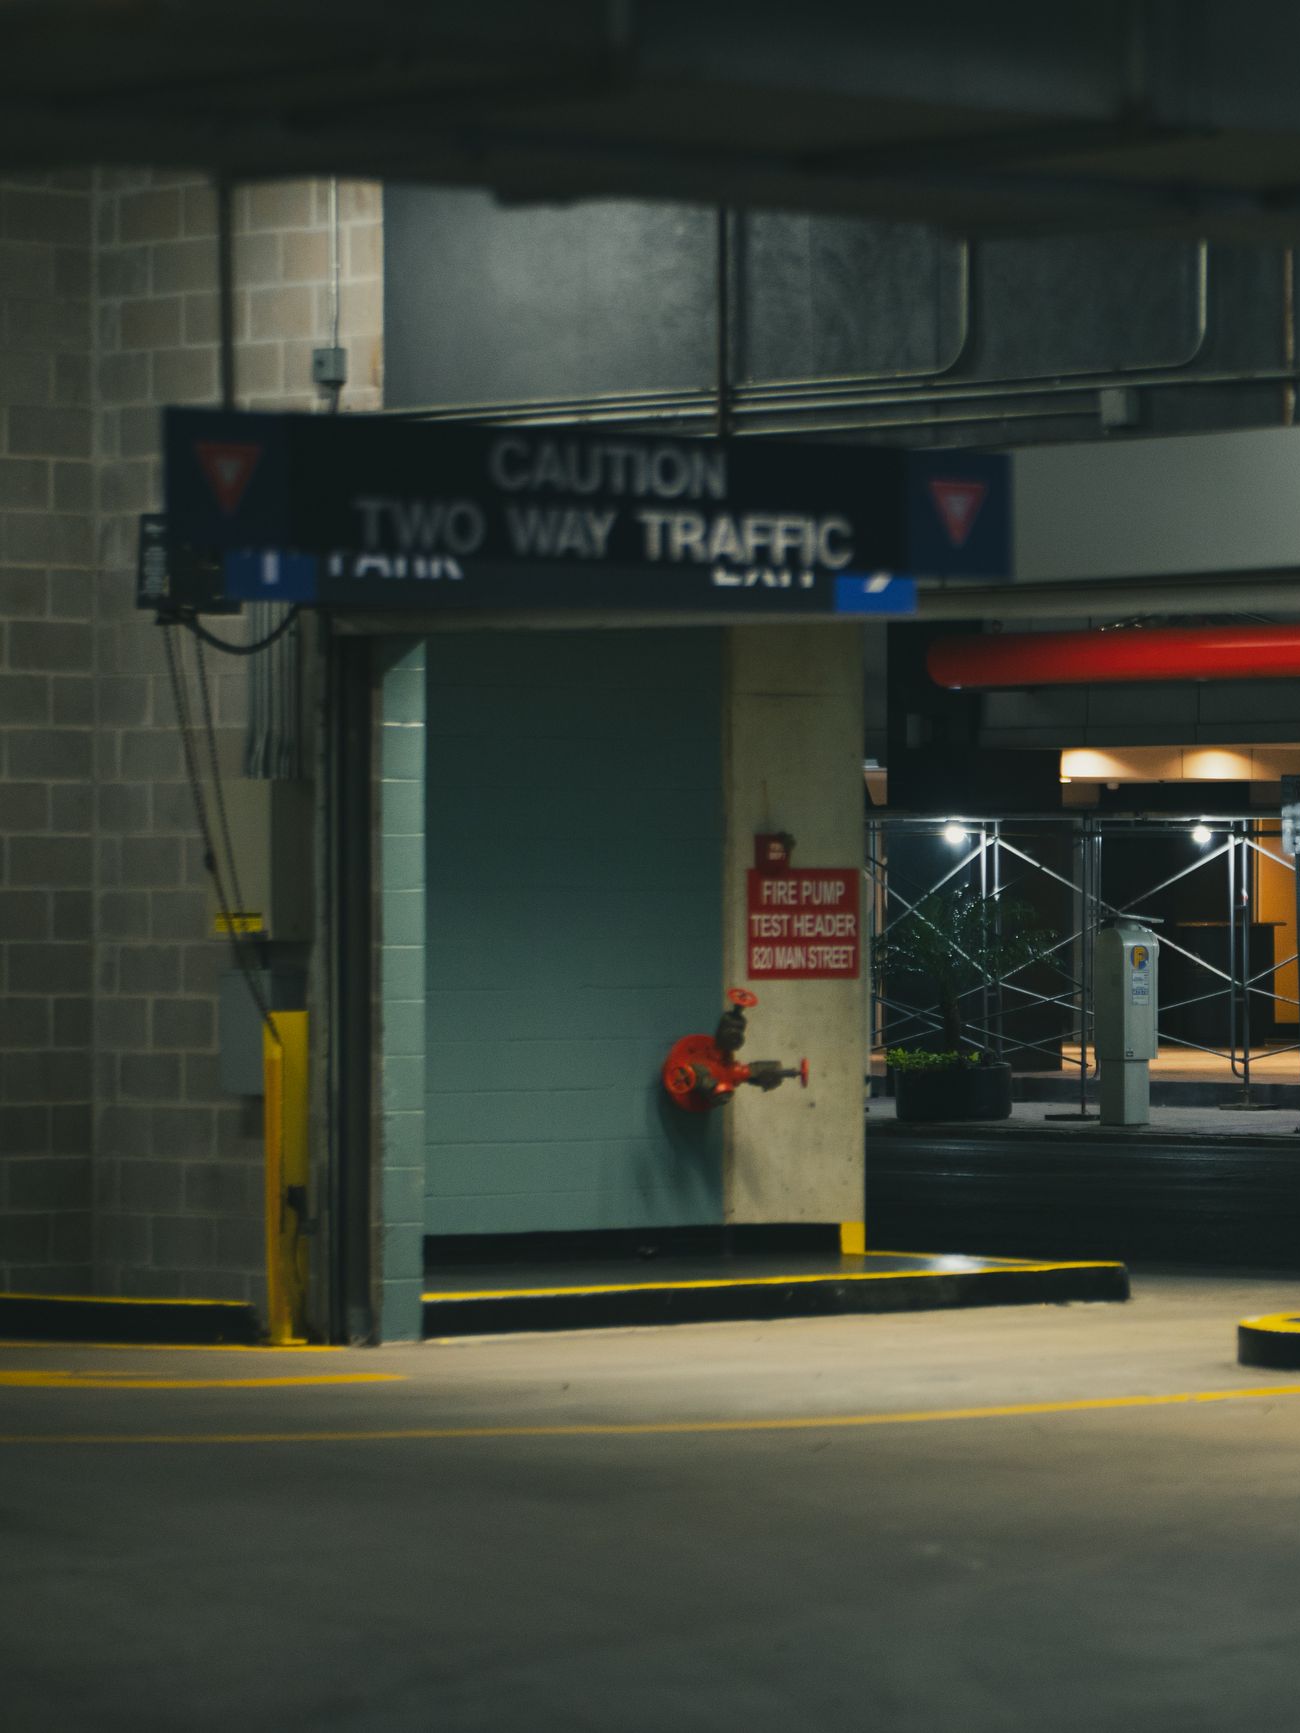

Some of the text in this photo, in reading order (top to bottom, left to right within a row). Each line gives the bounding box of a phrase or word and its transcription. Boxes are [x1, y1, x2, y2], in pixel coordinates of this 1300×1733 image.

[490, 439, 727, 499] CAUTION
[354, 499, 854, 570] TWO WAY TRAFFIC
[763, 880, 845, 905] FIRE PUMP
[751, 914, 856, 937] TEST HEADER
[775, 946, 806, 969] MAIN
[808, 946, 855, 969] STREET
